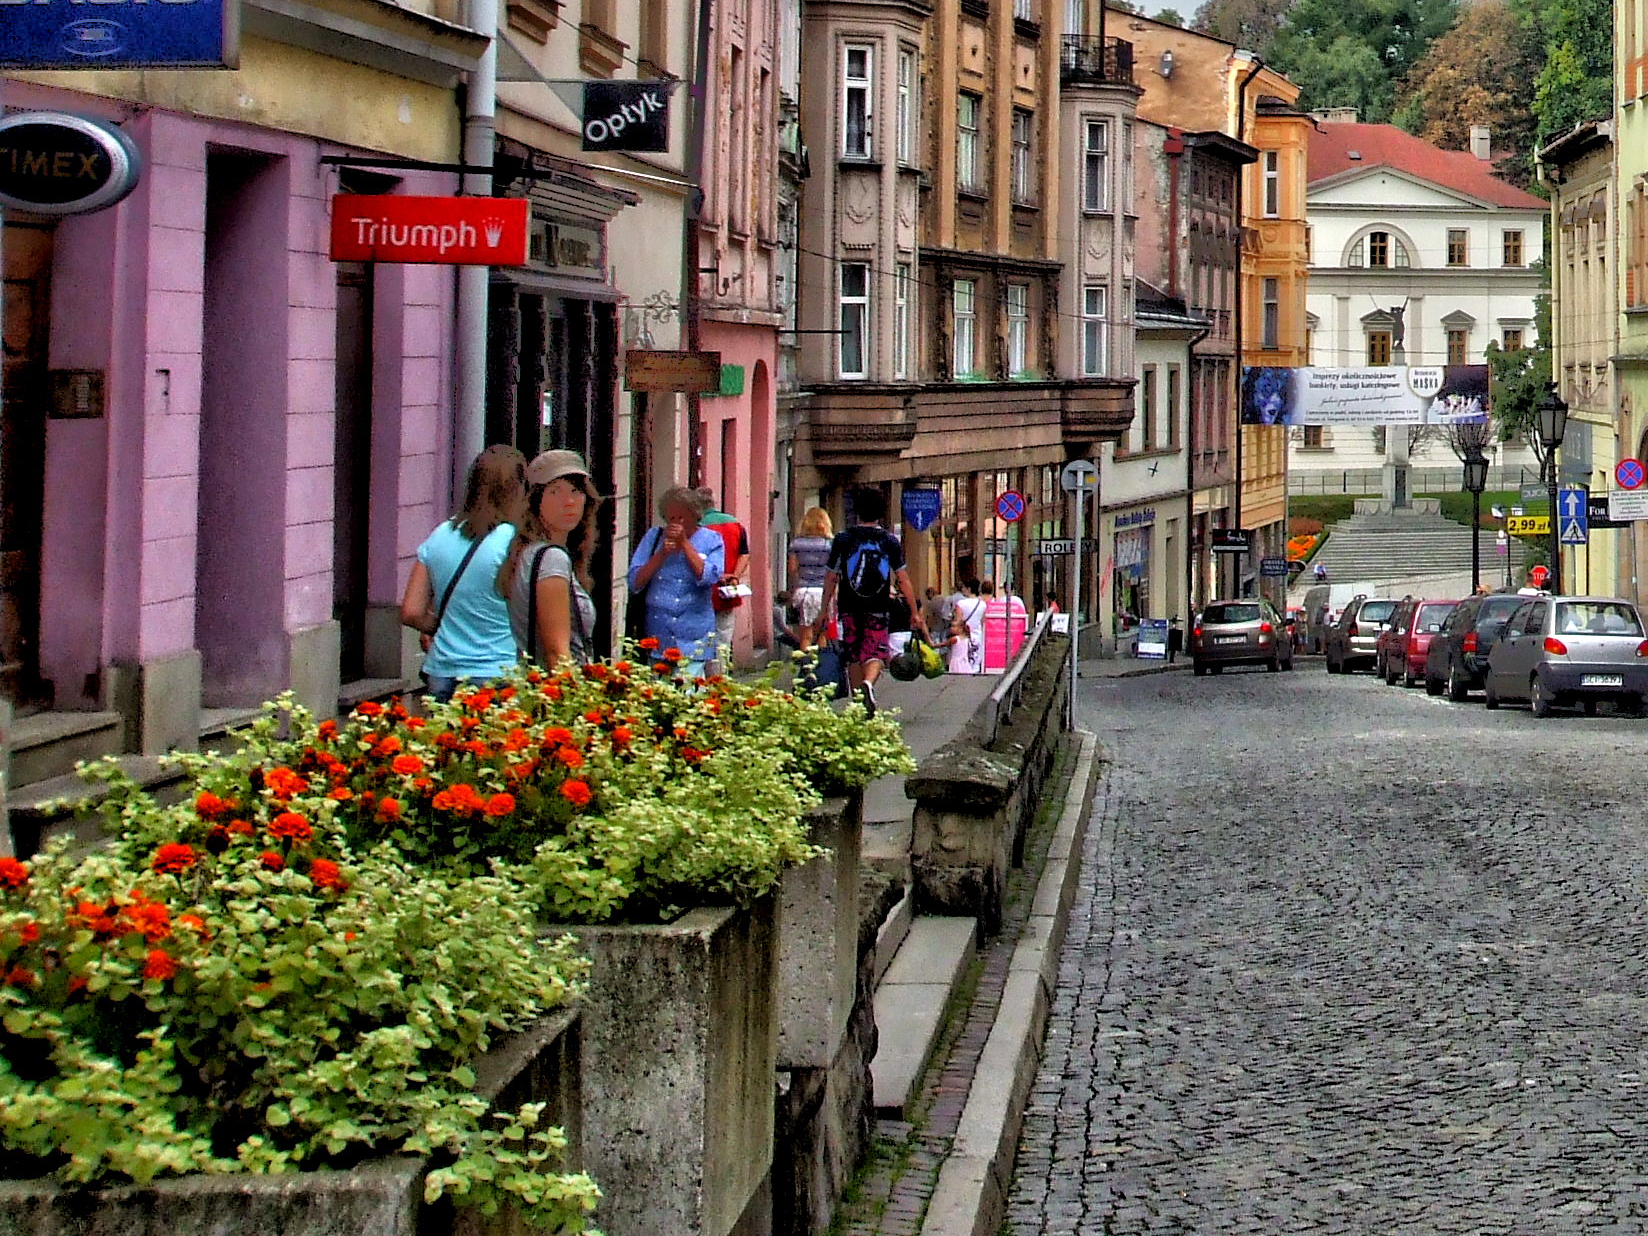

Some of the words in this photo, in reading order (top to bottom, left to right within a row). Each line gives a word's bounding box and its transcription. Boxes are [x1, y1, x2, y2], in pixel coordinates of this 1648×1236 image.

[584, 91, 666, 143] Optyk
[351, 216, 477, 255] Triumph
[1509, 519, 1536, 533] 2,99
[1044, 541, 1092, 553] ROLEY
